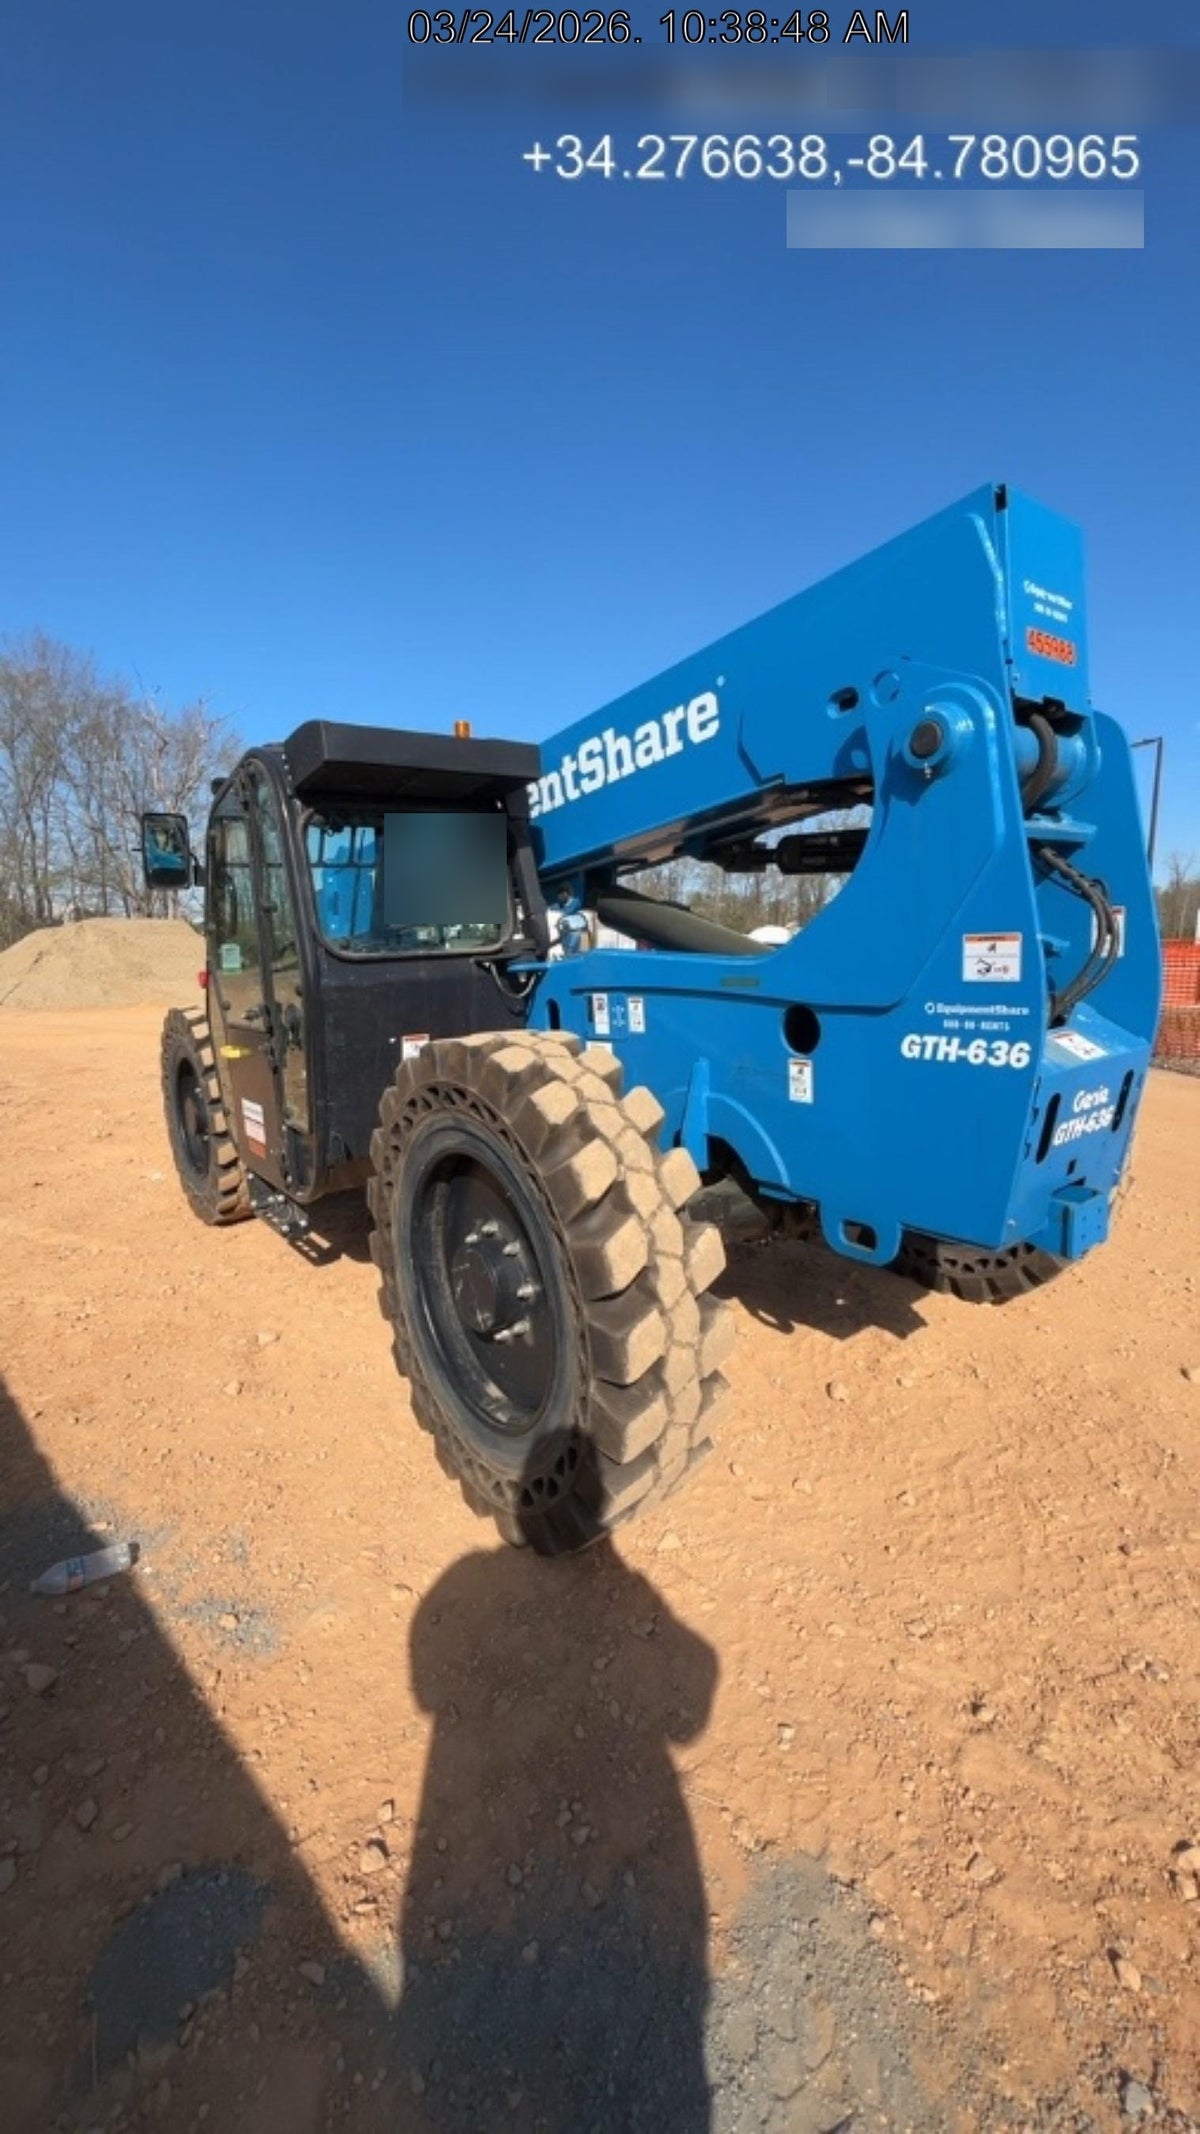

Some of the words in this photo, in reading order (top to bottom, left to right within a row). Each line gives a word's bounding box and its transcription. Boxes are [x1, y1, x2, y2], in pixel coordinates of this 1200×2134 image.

[901, 1033, 1031, 1069] GTH-636
[1073, 1084, 1109, 1113] Genie
[1052, 1104, 1115, 1147] GTH-636
